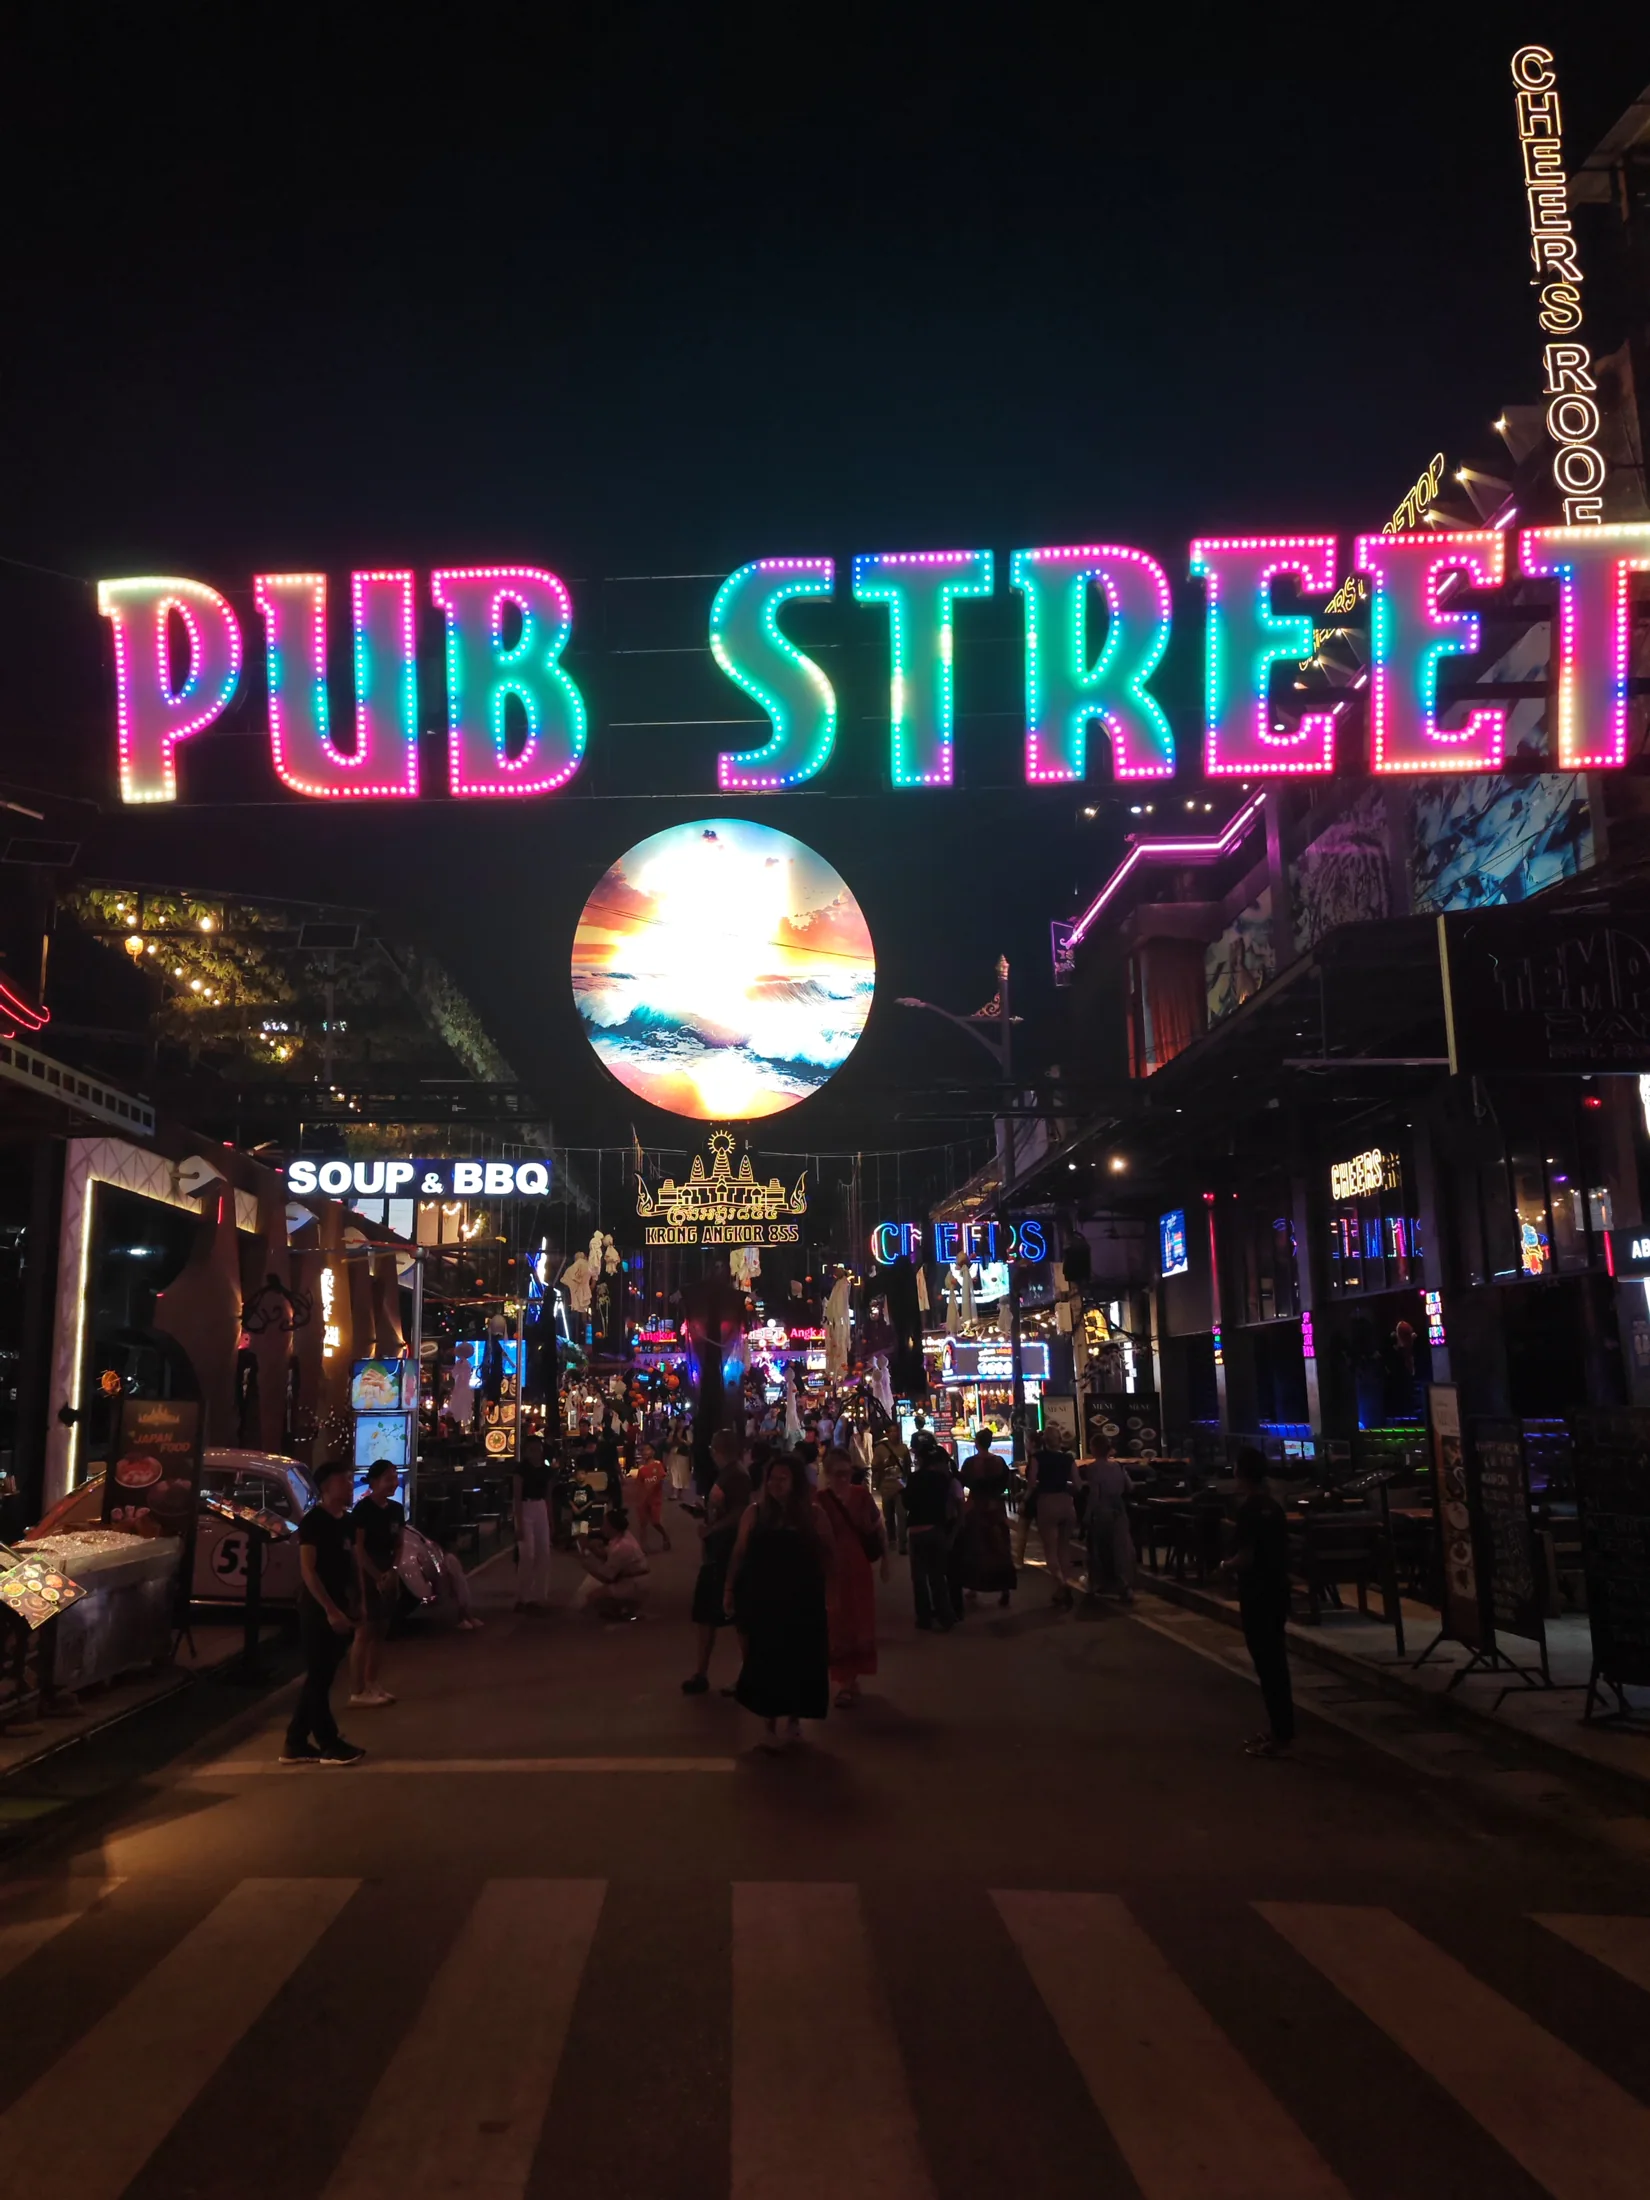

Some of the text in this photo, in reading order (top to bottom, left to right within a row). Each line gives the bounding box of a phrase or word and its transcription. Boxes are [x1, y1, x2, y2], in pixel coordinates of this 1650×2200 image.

[1511, 45, 1584, 333] CHEERS
[98, 523, 1650, 804] PUB STREET
[287, 1160, 550, 1196] SOUP & BBQ
[645, 1224, 799, 1244] KRONG ANGKOR 855
[639, 1330, 678, 1342] Angkor
[133, 1432, 174, 1444] JAPAN
[159, 1443, 191, 1453] FOOD
[217, 1540, 248, 1574] 5
